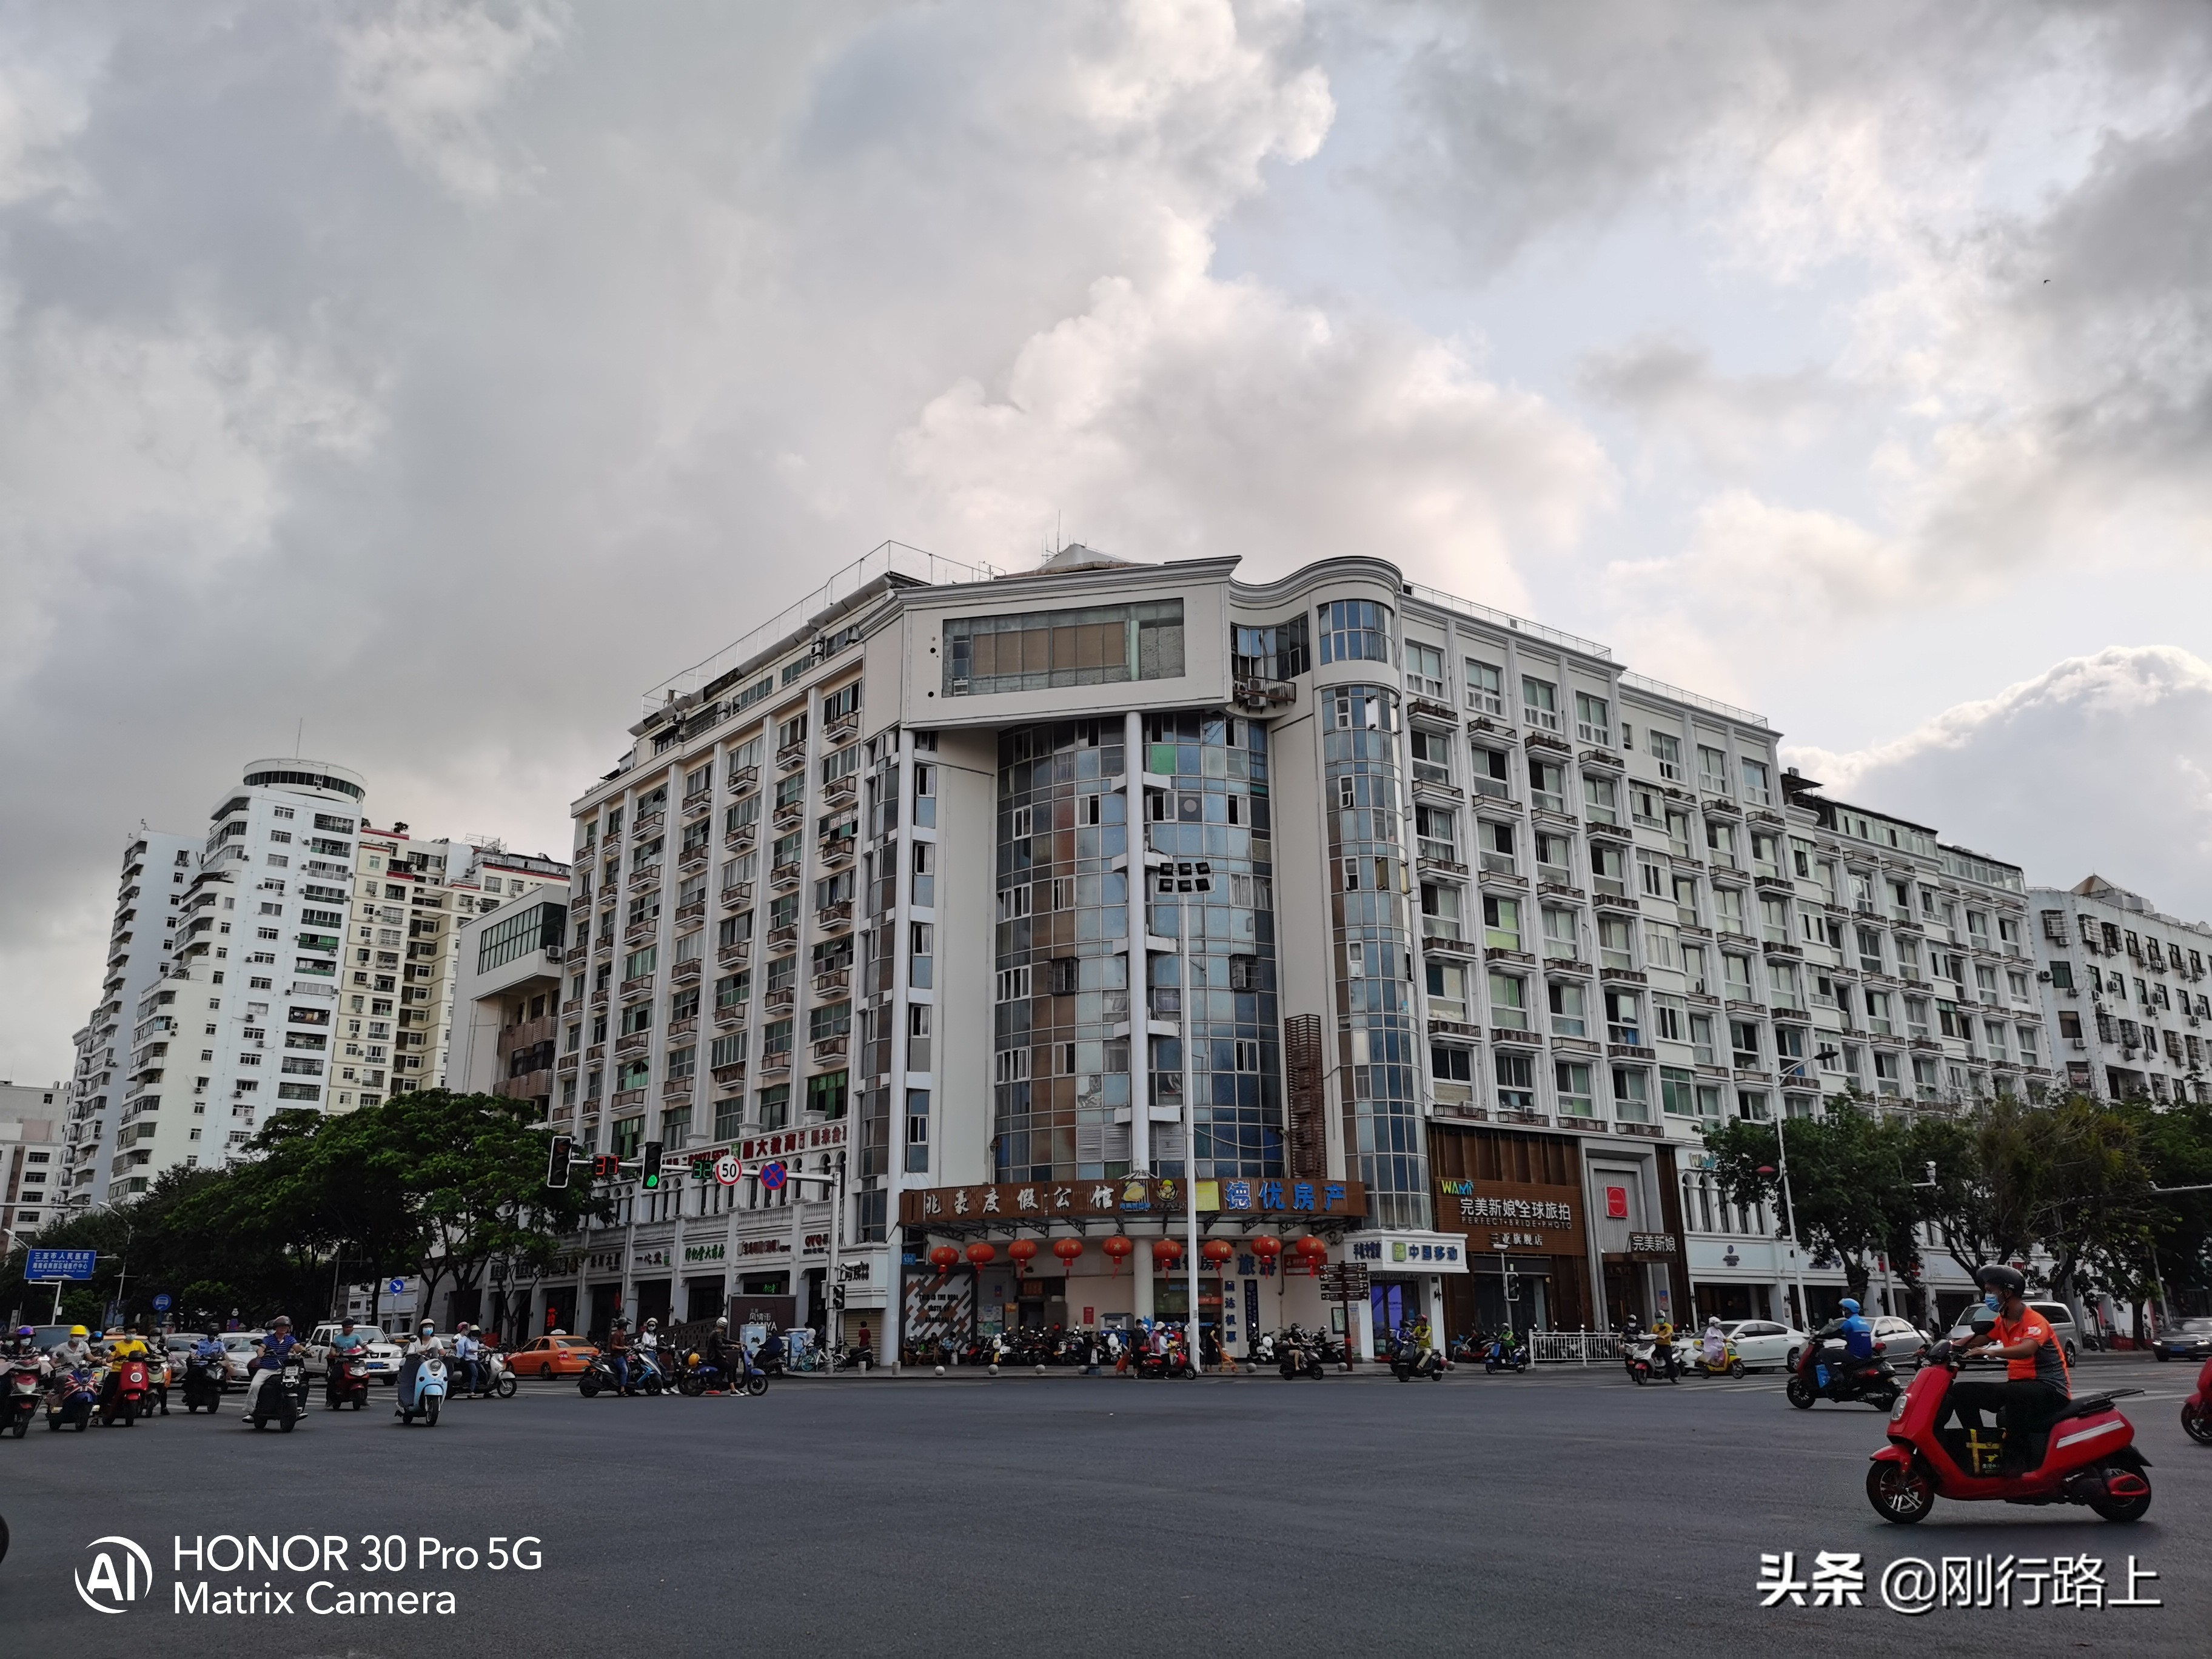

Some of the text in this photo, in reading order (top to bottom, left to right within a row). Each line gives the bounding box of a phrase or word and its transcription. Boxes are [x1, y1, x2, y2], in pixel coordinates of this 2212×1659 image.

[722, 1163, 737, 1178] 50
[1225, 1180, 1346, 1212] 德优房产
[1490, 1232, 1543, 1247] 三亚旗舰店
[1632, 1235, 1677, 1253] 完美新娘
[1409, 1244, 1457, 1261] 中国移动
